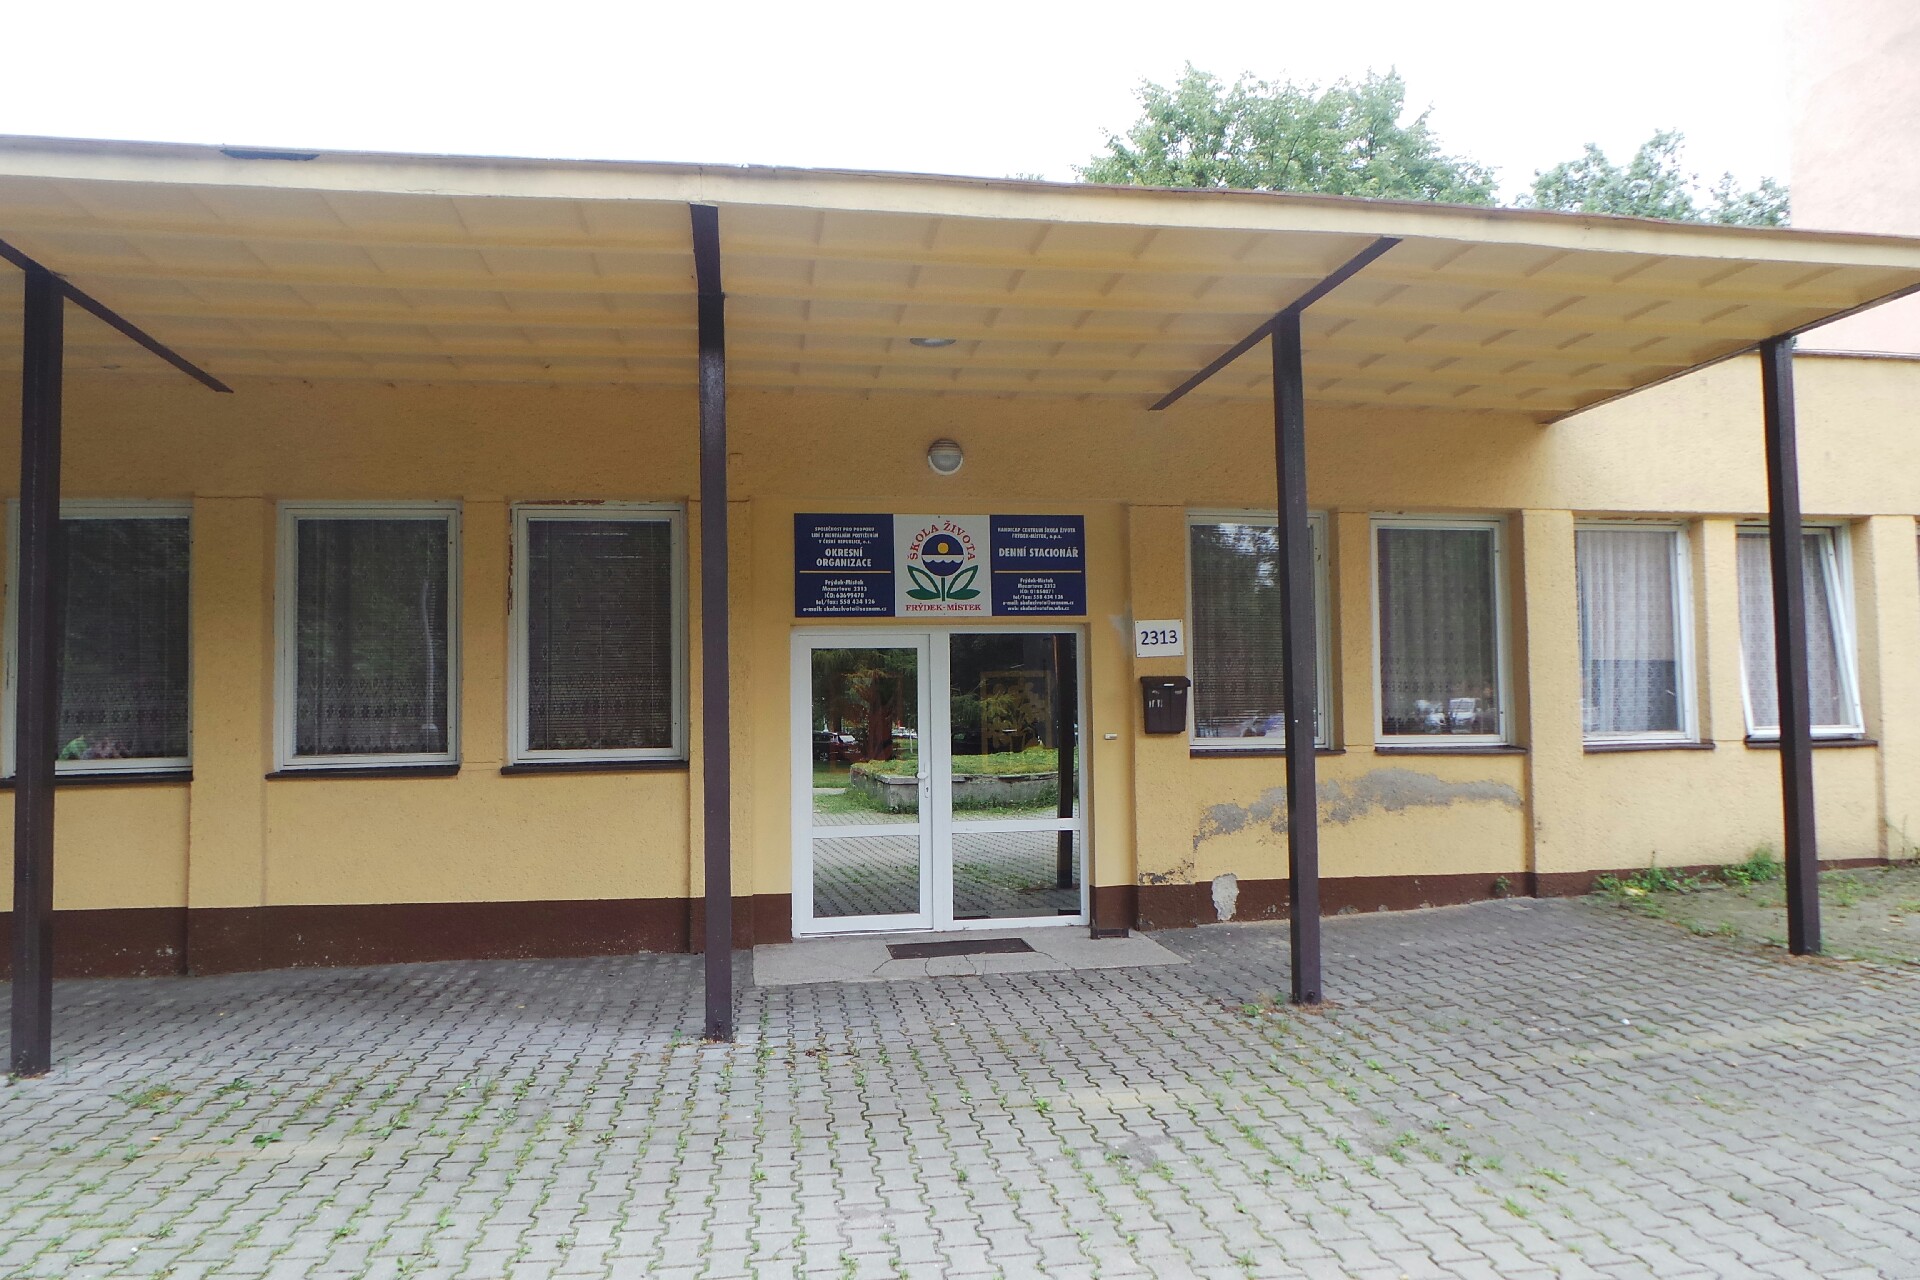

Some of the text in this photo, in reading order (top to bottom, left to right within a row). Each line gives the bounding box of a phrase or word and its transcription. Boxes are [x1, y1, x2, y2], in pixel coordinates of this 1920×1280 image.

[907, 520, 976, 560] ŠKOLA ŽIVOTA
[825, 547, 863, 557] OKRESNÍ
[999, 546, 1078, 557] DENNÍ STACIONÁŘ
[816, 558, 871, 567] ORGANIZACE
[1141, 630, 1177, 645] 2313
